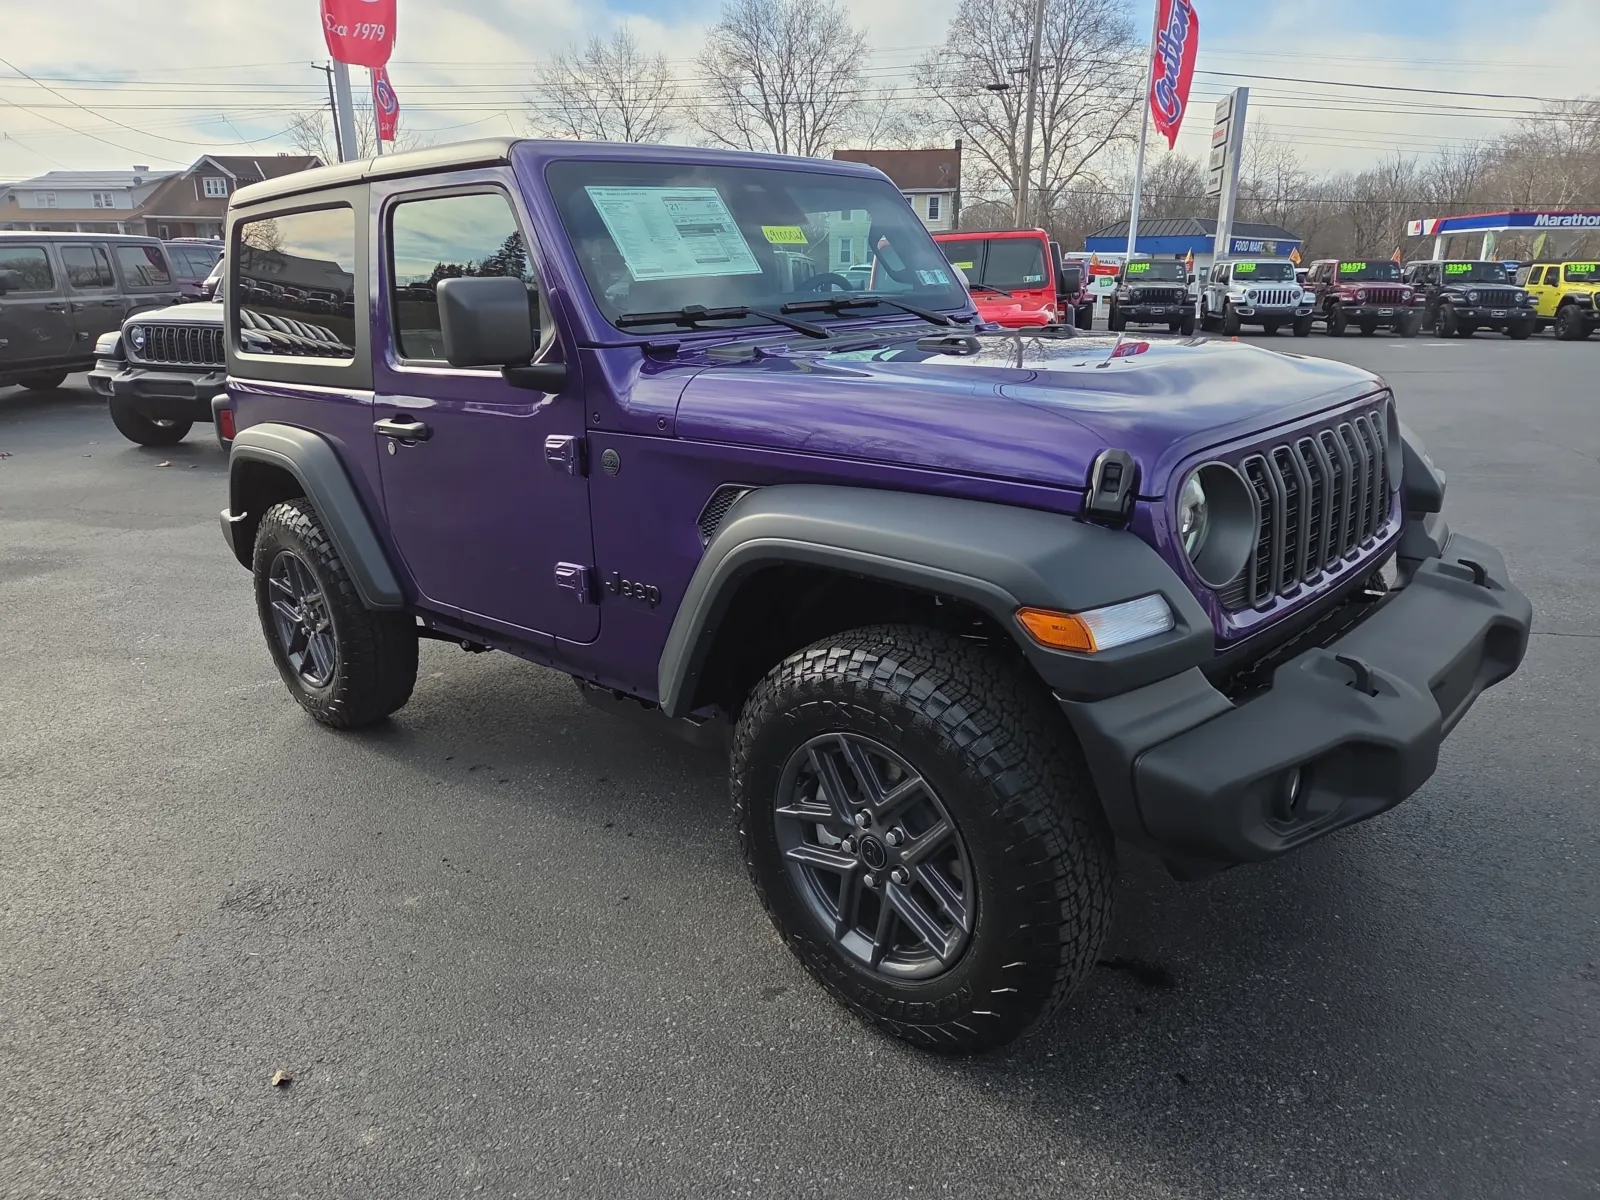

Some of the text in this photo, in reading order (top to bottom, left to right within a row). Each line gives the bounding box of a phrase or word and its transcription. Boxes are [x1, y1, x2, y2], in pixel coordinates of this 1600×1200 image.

[352, 22, 386, 41] 1979
[1234, 240, 1265, 252] FOOD MART
[605, 571, 661, 609] Jeep
